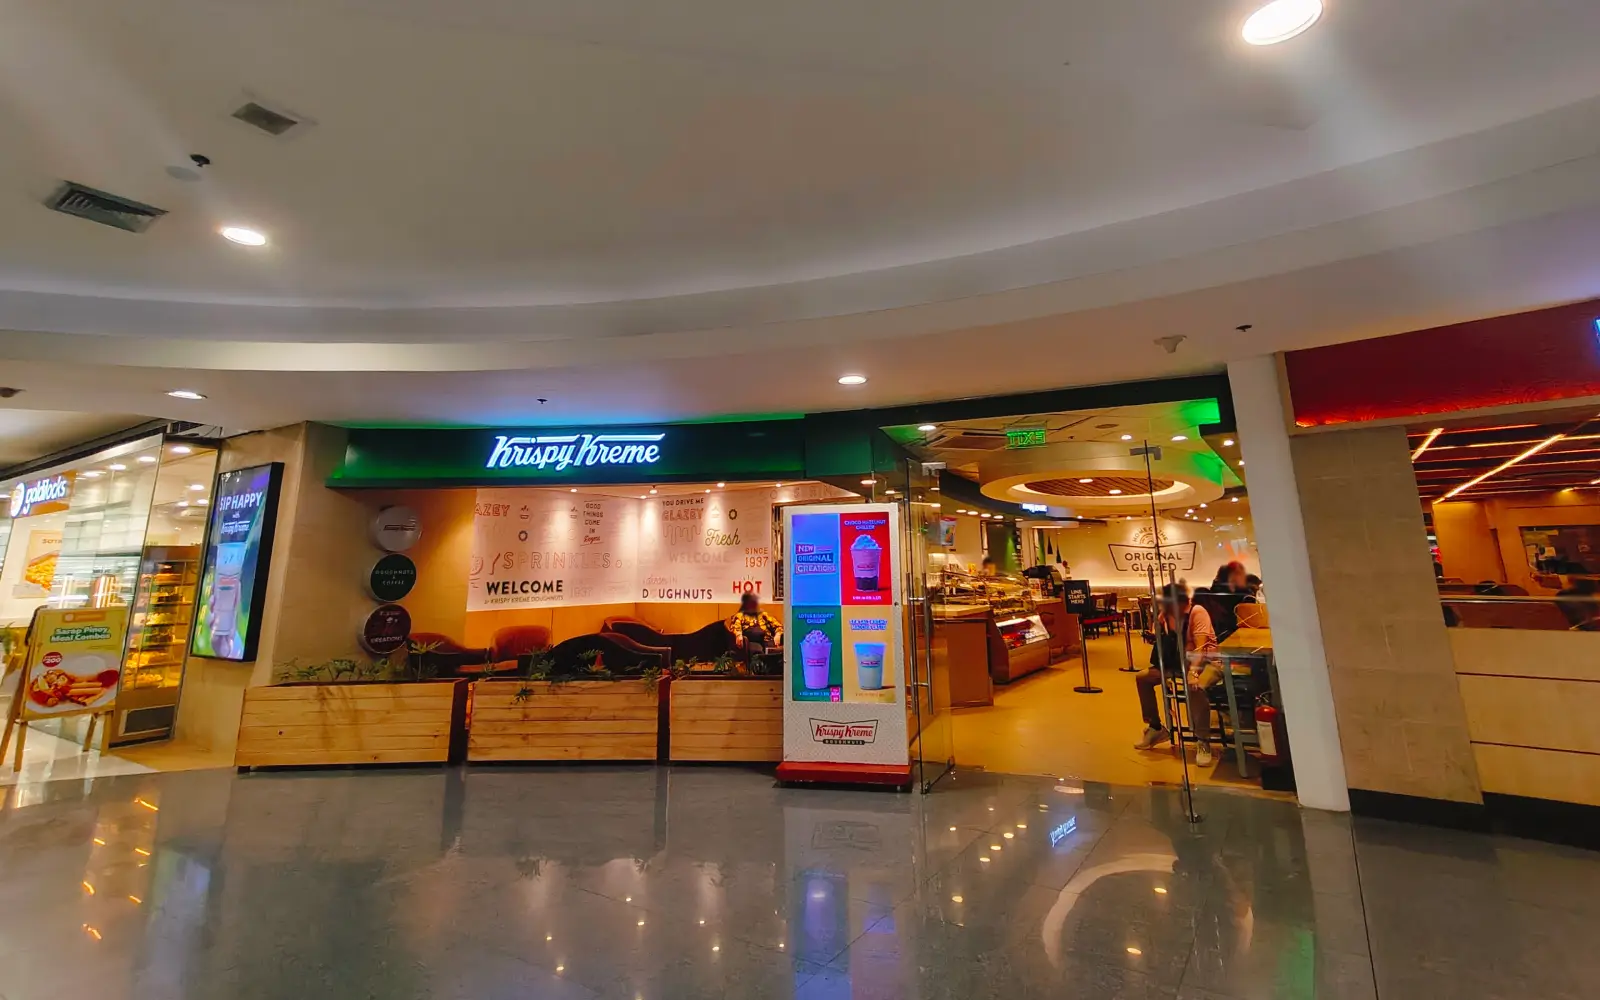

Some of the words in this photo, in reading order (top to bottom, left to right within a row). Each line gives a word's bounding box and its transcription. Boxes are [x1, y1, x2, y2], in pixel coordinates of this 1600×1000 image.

[486, 434, 580, 471] Krispy
[573, 433, 666, 467] Kreme
[219, 496, 232, 512] SIP
[231, 491, 263, 510] HAPPY
[675, 498, 694, 506] DRIVE
[662, 508, 704, 521] GLAZEY
[705, 527, 741, 547] Fresh
[745, 547, 769, 555] SINCE
[1124, 551, 1182, 561] ORIGINAL
[503, 551, 612, 570] SPRINKLES
[745, 556, 769, 568] 1937
[798, 554, 832, 562] ORIGINAL
[1131, 562, 1177, 572] GLAZED
[486, 579, 563, 597] WELCOME
[733, 580, 762, 594] HOT
[83, 626, 109, 634] Pinoy
[815, 723, 846, 738] Krispy
[844, 725, 875, 737] Kreme
